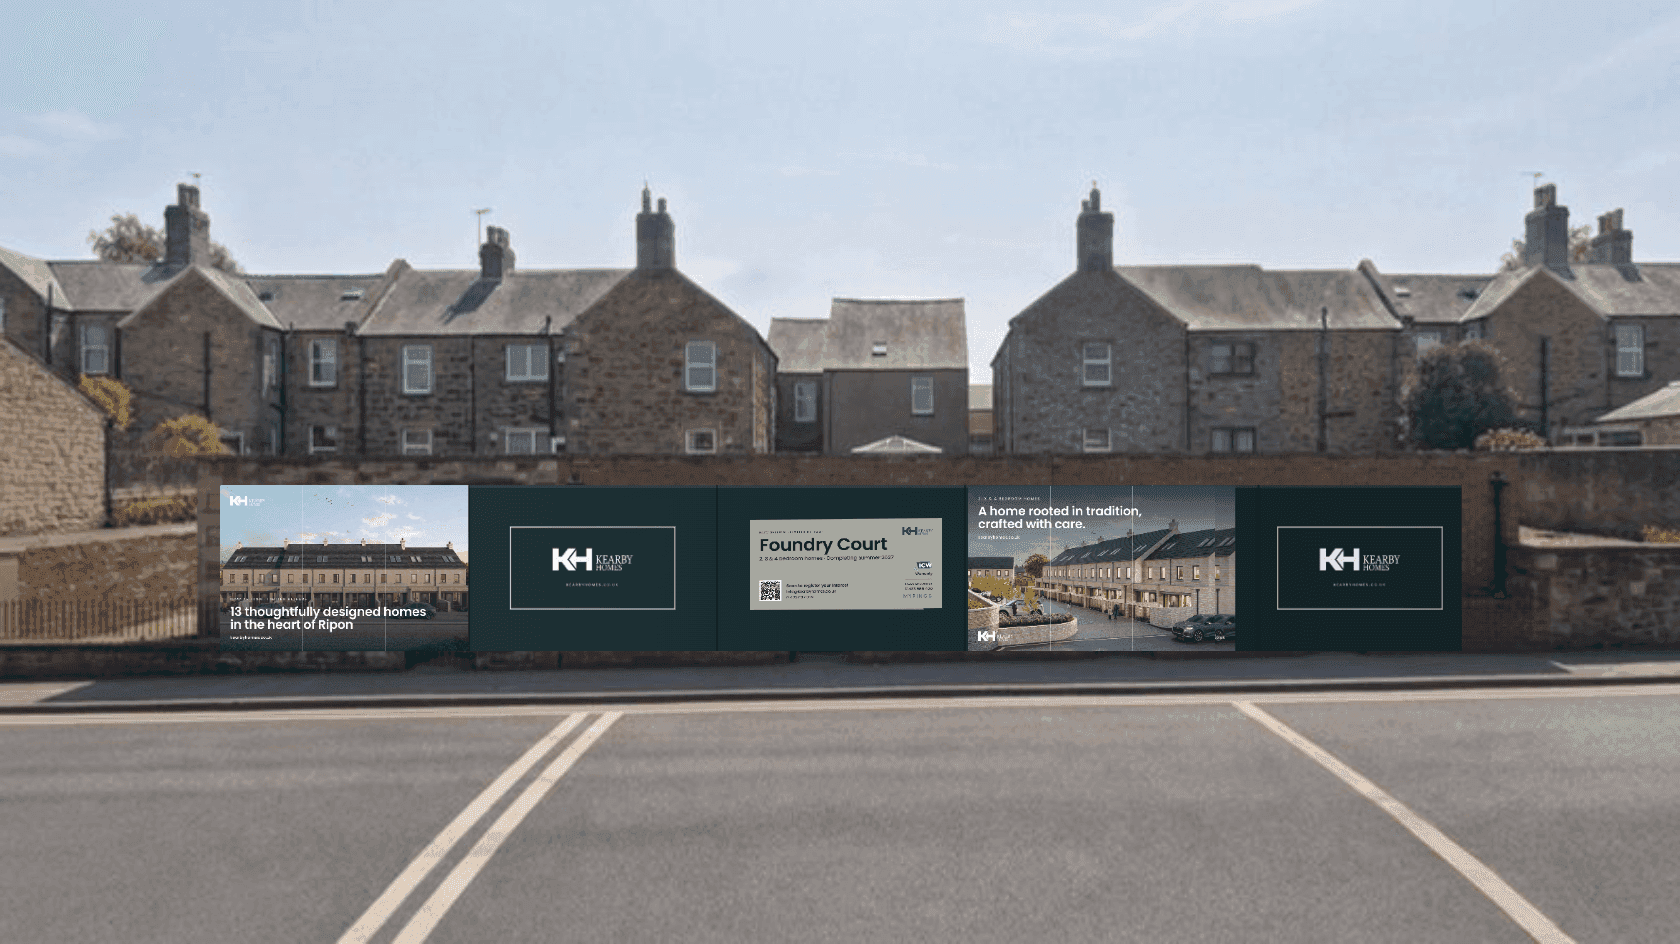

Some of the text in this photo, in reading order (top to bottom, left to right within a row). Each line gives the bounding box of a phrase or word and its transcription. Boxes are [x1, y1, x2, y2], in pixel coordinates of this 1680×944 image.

[230, 495, 248, 506] KH
[978, 505, 1142, 518] A home rooted in tradition,
[978, 518, 1086, 529] crafted with care.
[760, 537, 888, 556] Foundry Court
[552, 547, 634, 571] KH KEARBY
[1319, 547, 1401, 571] KH KEARBY
[230, 606, 427, 620] 13 thoughtfully designed homes
[230, 619, 354, 633] in the heart of Ripon
[977, 630, 996, 642] KH
